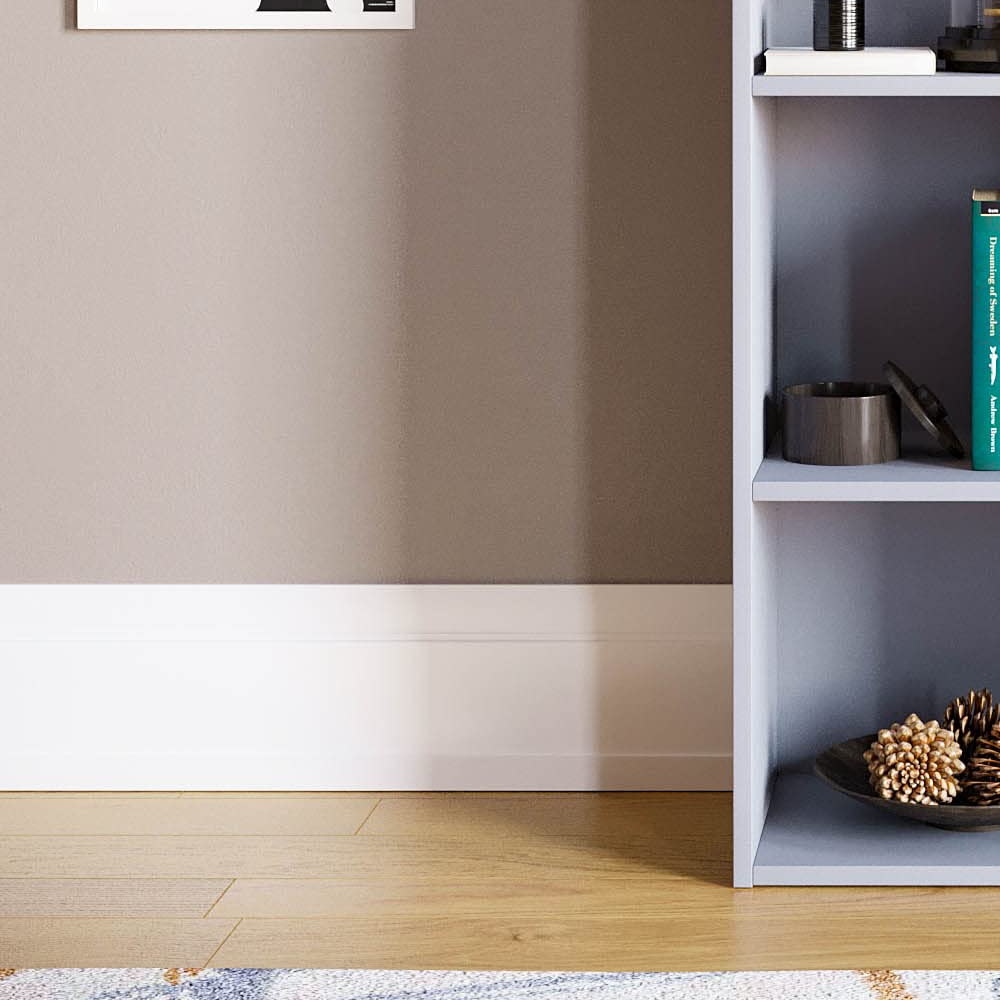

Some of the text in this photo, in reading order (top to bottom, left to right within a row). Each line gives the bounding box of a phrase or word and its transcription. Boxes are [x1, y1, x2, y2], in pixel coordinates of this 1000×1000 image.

[987, 236, 998, 337] Dreaming of Sweden
